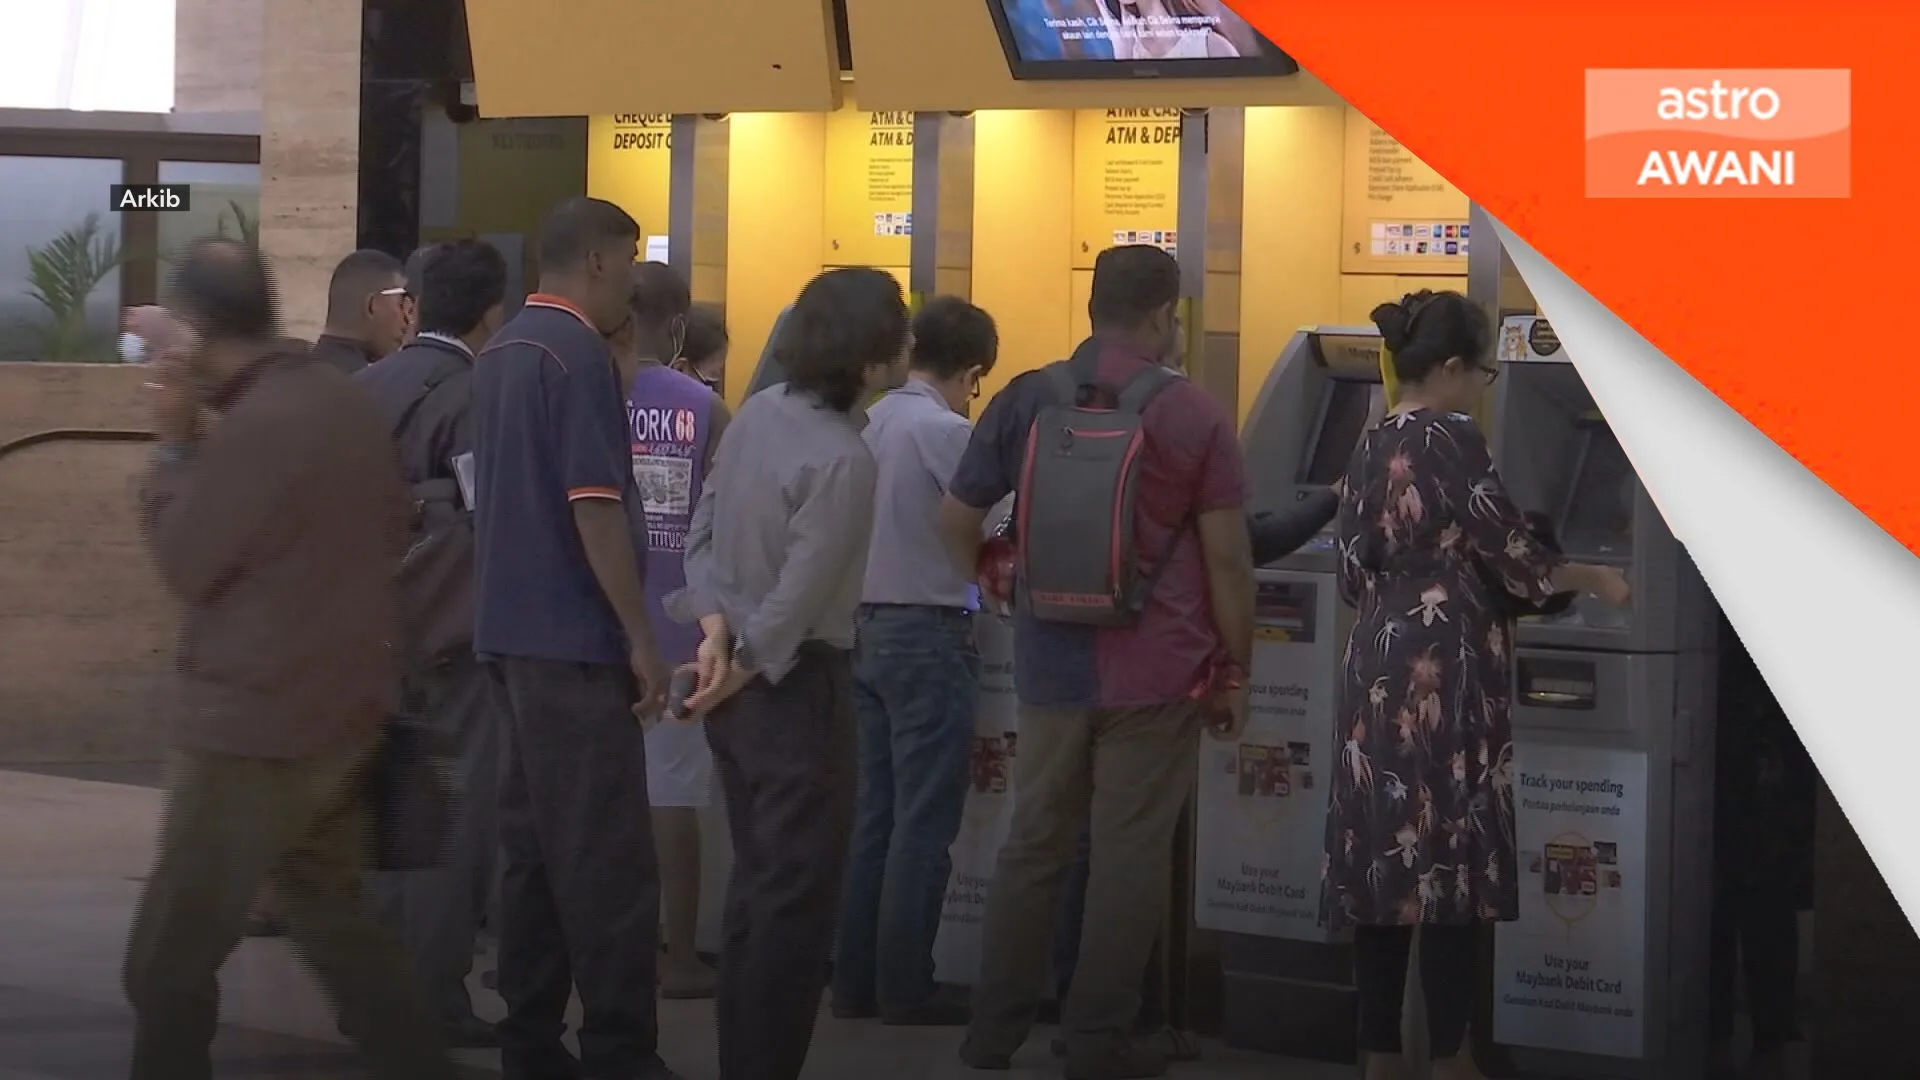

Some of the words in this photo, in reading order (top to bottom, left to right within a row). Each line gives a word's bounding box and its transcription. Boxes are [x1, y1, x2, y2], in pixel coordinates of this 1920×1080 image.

[870, 112, 894, 125] ATM
[614, 133, 664, 149] DEPOSIT
[870, 132, 894, 146] ATM
[1106, 126, 1137, 144] ATM
[1140, 126, 1150, 144] &
[675, 409, 696, 442] 68
[1520, 772, 1548, 788] Track
[1549, 779, 1573, 793] your
[1575, 779, 1623, 798] spending
[1544, 953, 1564, 969] Use
[1566, 958, 1590, 973] your
[1515, 970, 1563, 989] Maybank
[1565, 975, 1595, 992] Debit
[1596, 979, 1622, 994] Card
